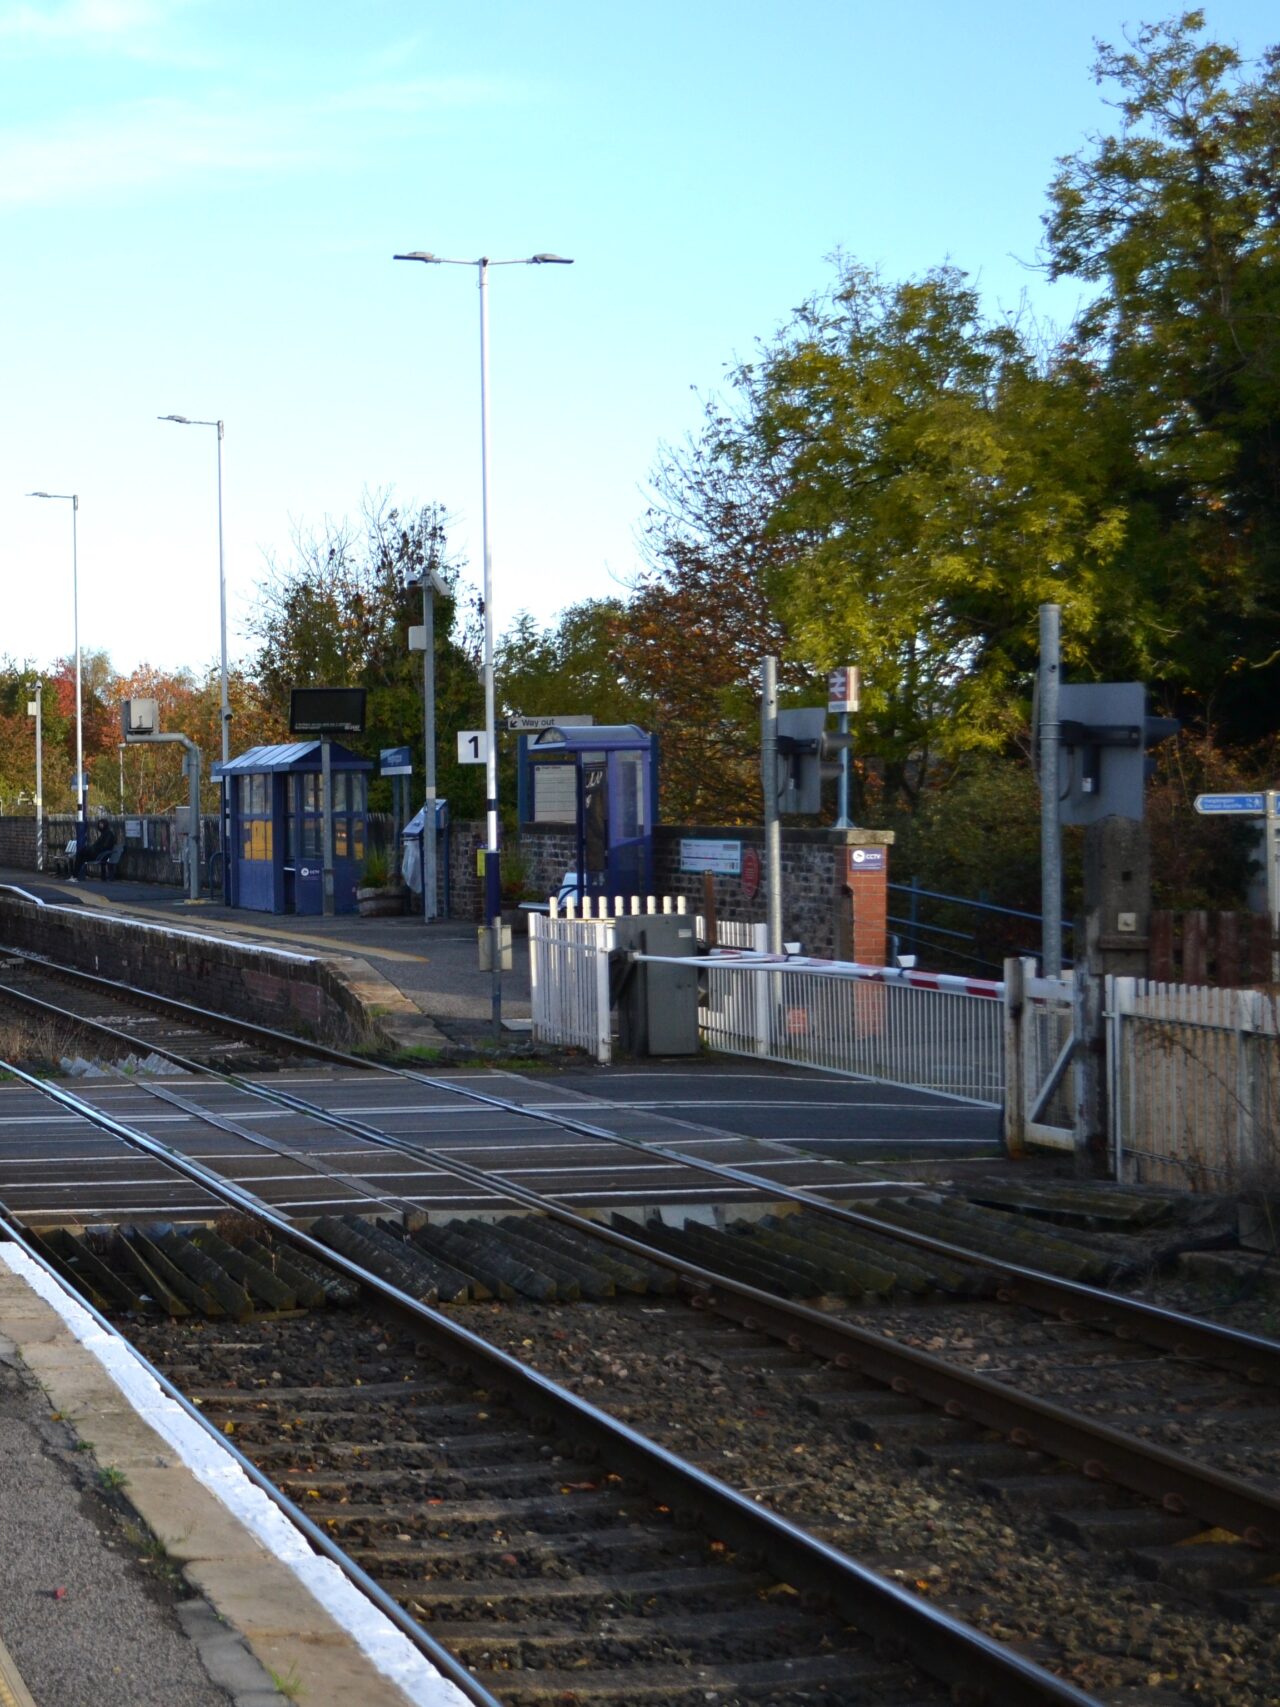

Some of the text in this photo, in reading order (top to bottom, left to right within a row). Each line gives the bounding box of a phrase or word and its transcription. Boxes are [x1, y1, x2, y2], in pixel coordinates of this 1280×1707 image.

[522, 718, 555, 728] Way out
[468, 736, 479, 758] 1
